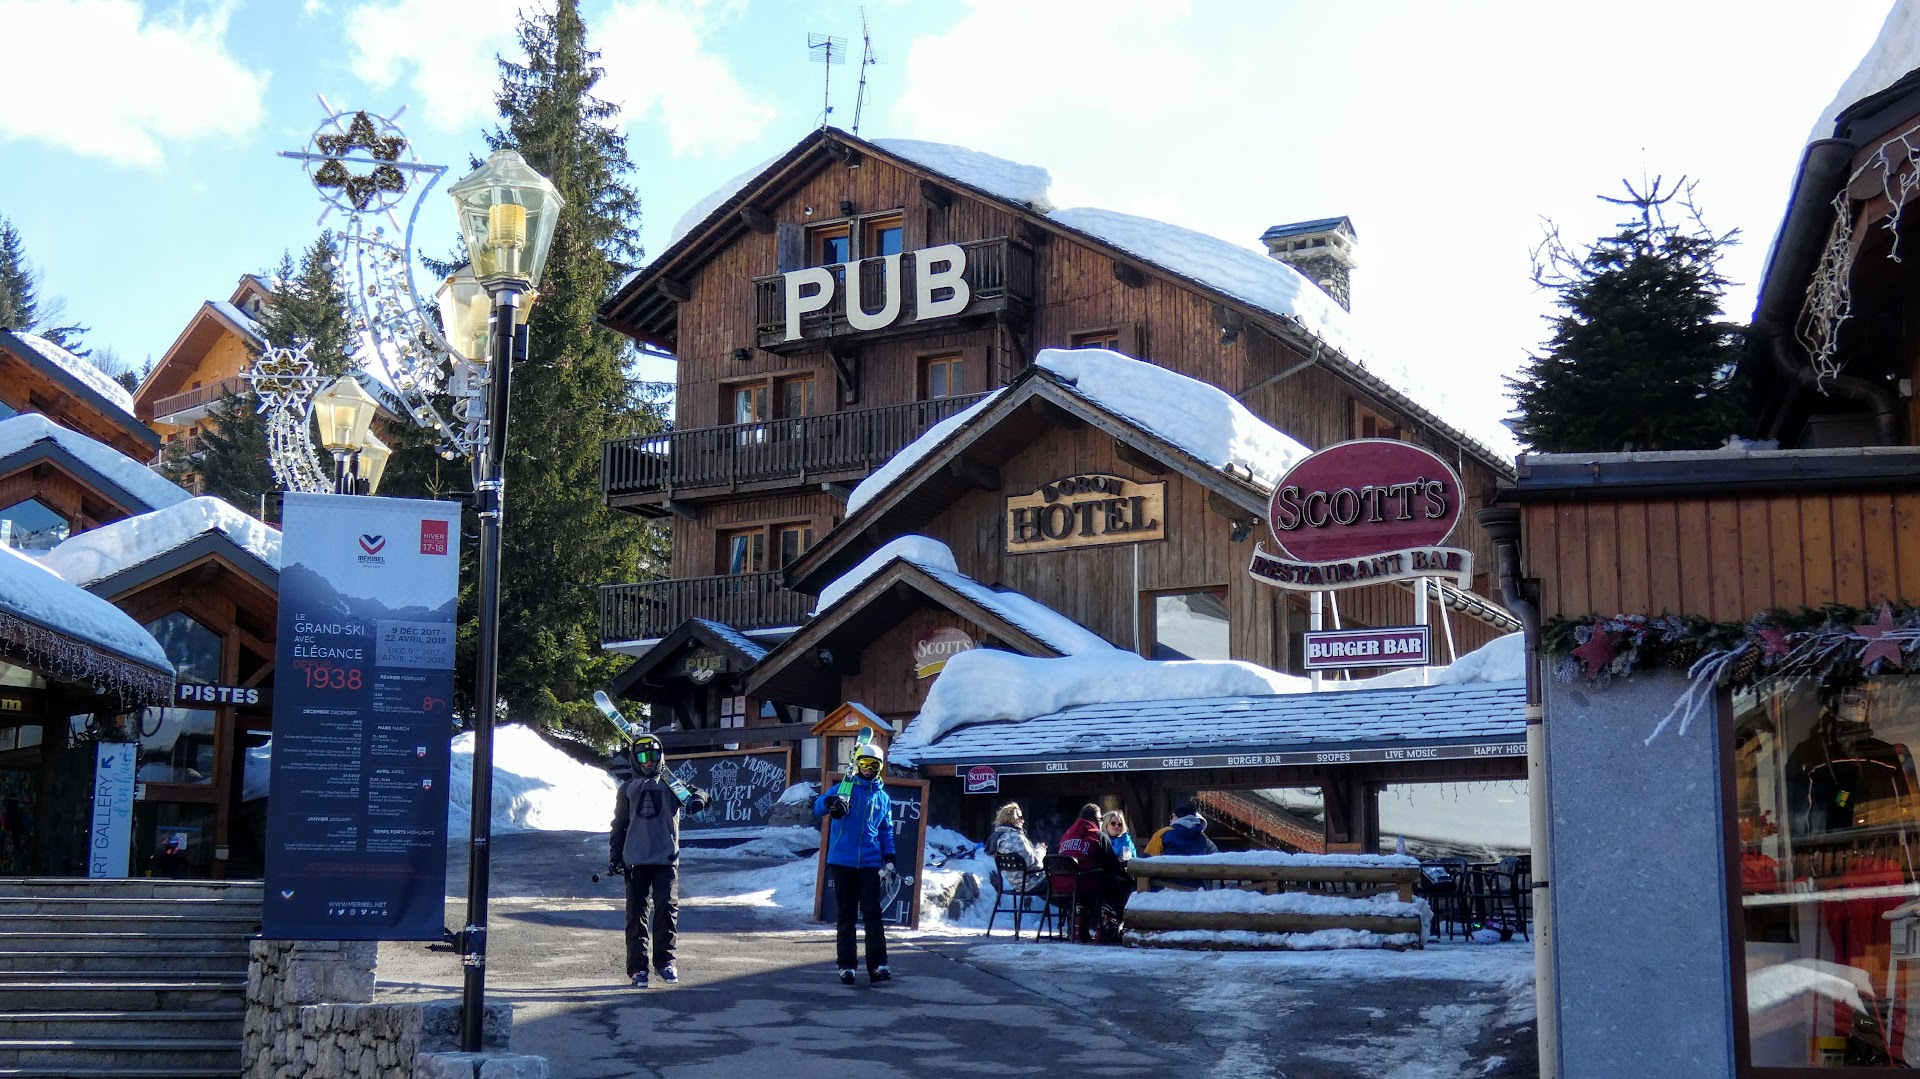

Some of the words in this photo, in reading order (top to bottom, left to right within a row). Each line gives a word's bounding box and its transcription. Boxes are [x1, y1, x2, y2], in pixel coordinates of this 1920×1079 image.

[782, 244, 970, 342] PUB
[1277, 476, 1446, 531] SCOTT'S
[1009, 495, 1156, 544] HOTEL
[423, 543, 444, 553] 17-18
[1250, 553, 1404, 586] RESTAURANT
[1411, 550, 1463, 572] BAR
[295, 613, 306, 621] LE
[294, 623, 341, 635] GRAND
[345, 625, 365, 635] SKI
[421, 628, 440, 636] 2017
[398, 635, 423, 644] AVRIL
[426, 637, 446, 645] 2018
[917, 639, 971, 658] SCOTT'S
[1309, 640, 1380, 658] BURGER
[1384, 638, 1421, 655] BAR
[293, 643, 363, 660] ÉLÉGANCE
[382, 655, 406, 663] APRIL
[426, 656, 446, 664] 2018
[388, 647, 405, 655] DEC
[422, 648, 440, 656] 2017
[685, 656, 721, 672] PUB
[304, 667, 363, 690] 1938
[181, 684, 259, 705] PISTES
[1046, 762, 1069, 772] GRILL
[1101, 760, 1129, 770] SNACK
[1162, 758, 1194, 767] CREPES
[1227, 756, 1263, 765] BURGER
[1265, 755, 1282, 764] BAR
[1317, 752, 1351, 762] SOUPES
[1385, 750, 1404, 759] LIVE
[1406, 749, 1437, 758] MUSIC
[1473, 745, 1504, 756] HAPPY
[969, 772, 995, 782] SCOTT'S
[94, 775, 113, 849] GALLERY
